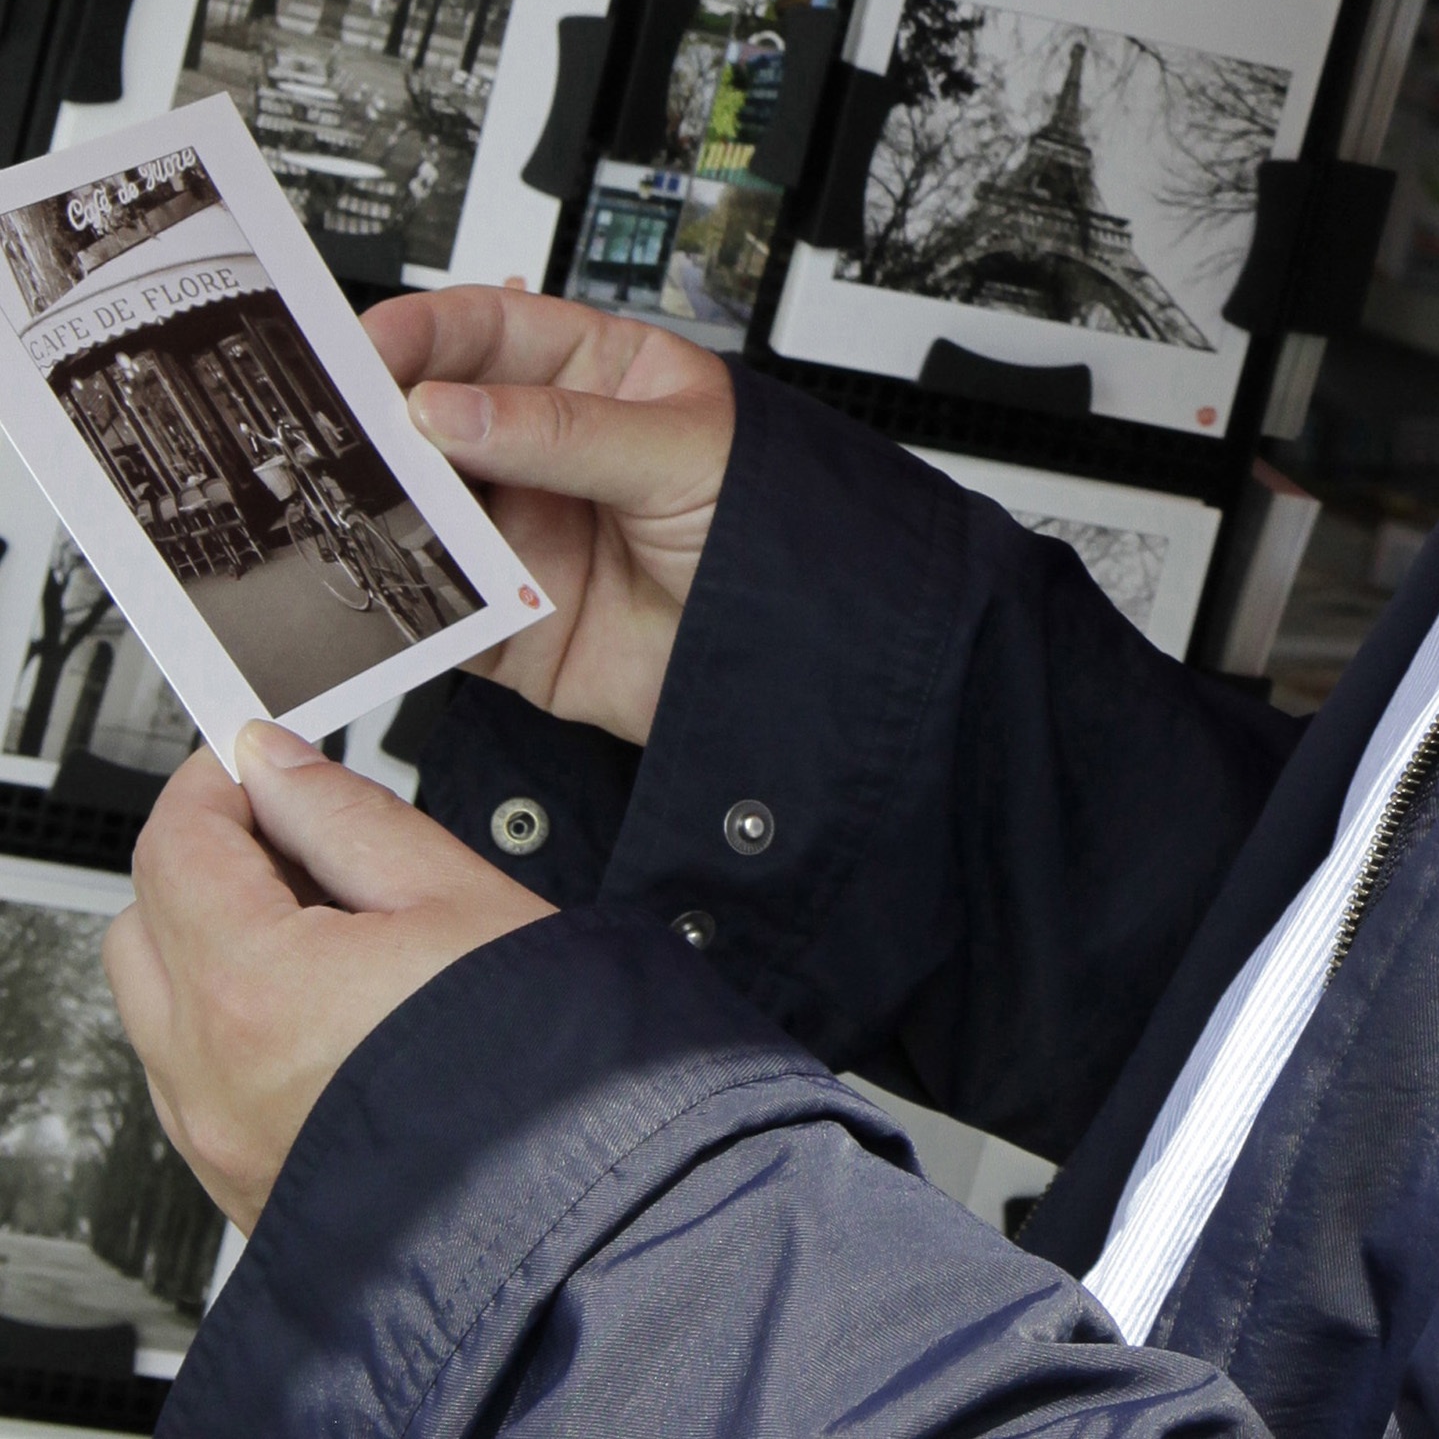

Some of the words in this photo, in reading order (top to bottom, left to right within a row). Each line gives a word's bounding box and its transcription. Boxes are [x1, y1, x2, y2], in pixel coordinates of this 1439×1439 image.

[67, 189, 113, 234] Café
[118, 180, 140, 205] de
[138, 147, 197, 190] Flore
[29, 316, 91, 361] CAFE
[93, 298, 136, 330] DE
[141, 268, 240, 312] FLORE
